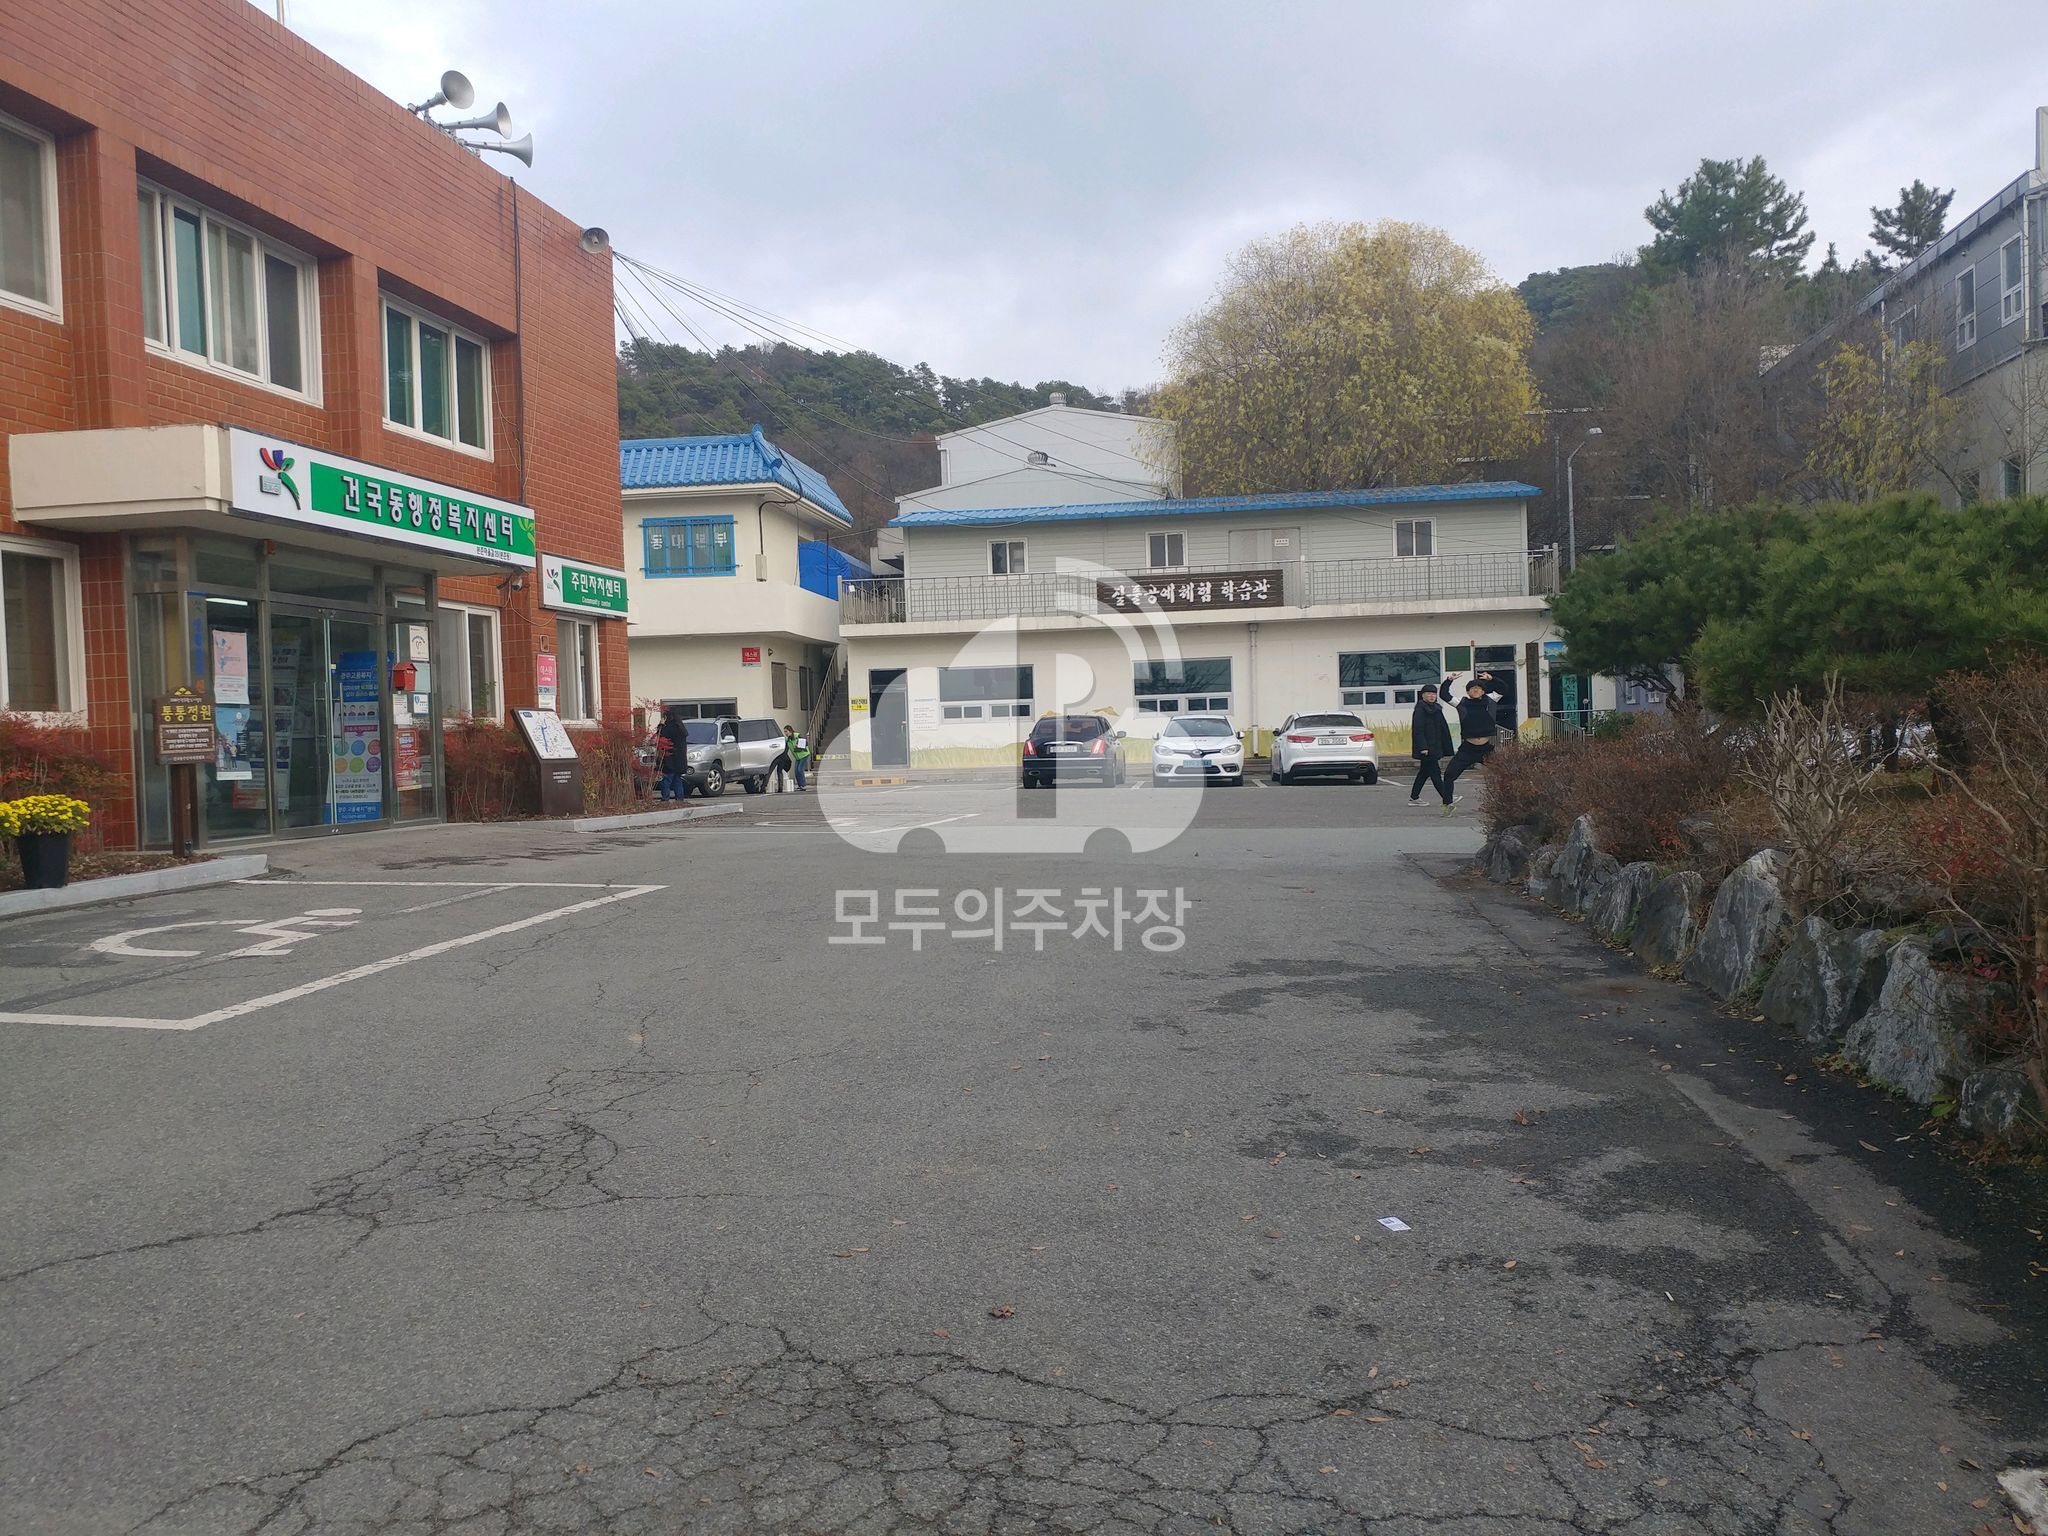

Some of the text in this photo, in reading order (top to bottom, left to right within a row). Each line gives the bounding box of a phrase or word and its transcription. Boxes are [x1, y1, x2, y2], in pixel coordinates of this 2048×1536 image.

[341, 475, 514, 546] 건국동행정복지센터
[571, 571, 622, 599] 주민자치센터
[1221, 578, 1271, 602] 학습관
[161, 704, 212, 722] 통통정원
